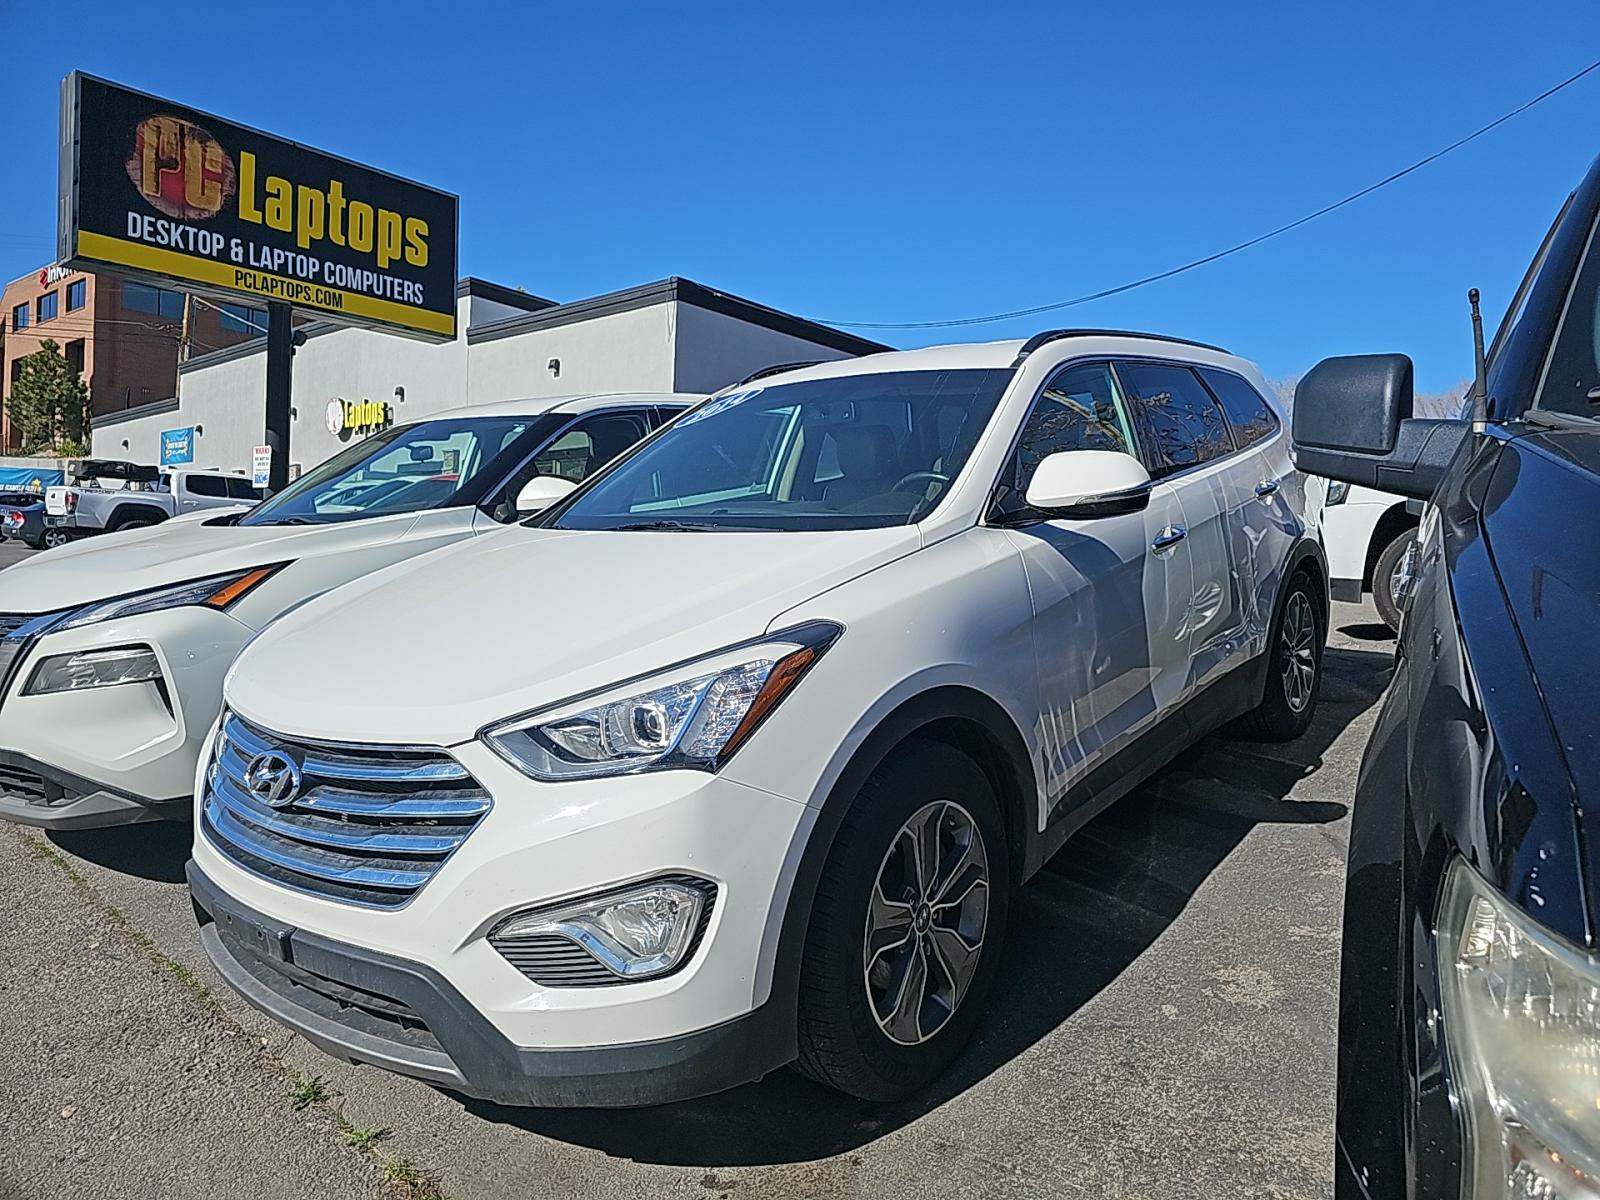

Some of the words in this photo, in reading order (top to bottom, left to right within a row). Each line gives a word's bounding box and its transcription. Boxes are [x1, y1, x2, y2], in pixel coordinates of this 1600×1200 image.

[142, 116, 222, 211] PC
[239, 151, 429, 269] Laptops
[127, 211, 225, 257] DESKTOP
[230, 238, 244, 263] &
[249, 242, 320, 280] LAPTOP
[324, 261, 424, 305] COMPUTERS
[234, 269, 343, 309] PCLAPTOPS.COM
[344, 401, 384, 432] Laptops
